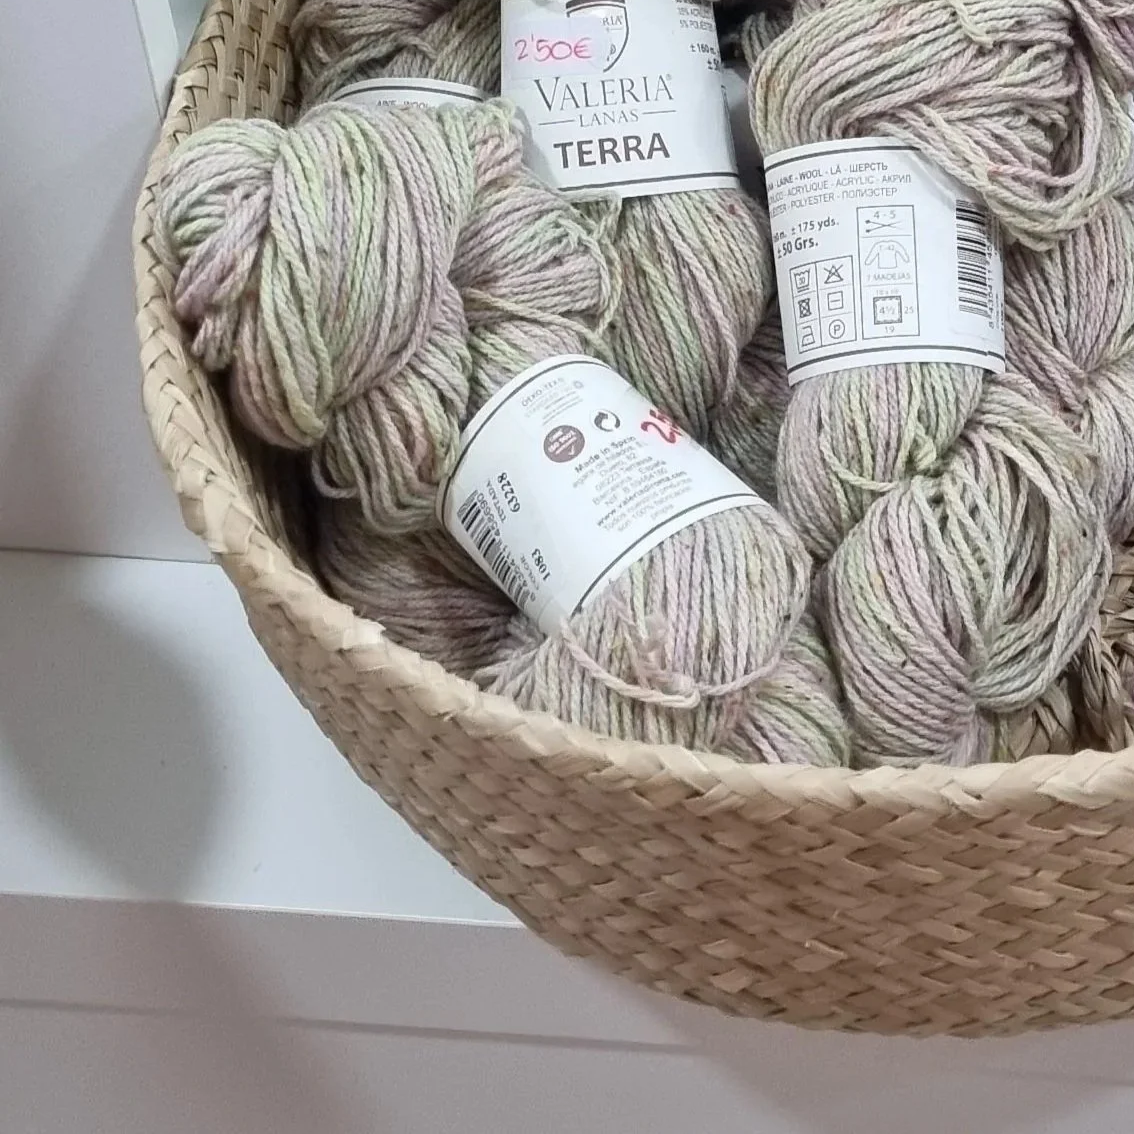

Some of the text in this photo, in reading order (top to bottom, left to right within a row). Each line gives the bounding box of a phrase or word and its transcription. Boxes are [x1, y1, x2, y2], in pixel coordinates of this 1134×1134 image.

[579, 109, 639, 128] LANAS
[553, 133, 670, 169] TERRA
[800, 169, 823, 181] WOOL
[835, 175, 874, 187] ACRYLIC
[790, 192, 835, 209] POLYESTER
[798, 220, 815, 234] 175
[817, 216, 840, 233] yds.
[794, 236, 819, 252] Grs.
[904, 306, 914, 315] 25
[884, 326, 895, 334] 19
[574, 454, 600, 473] Made
[600, 447, 610, 456] in
[497, 472, 521, 514] 63228
[476, 492, 501, 537] 458690
[531, 548, 552, 581] 1083
